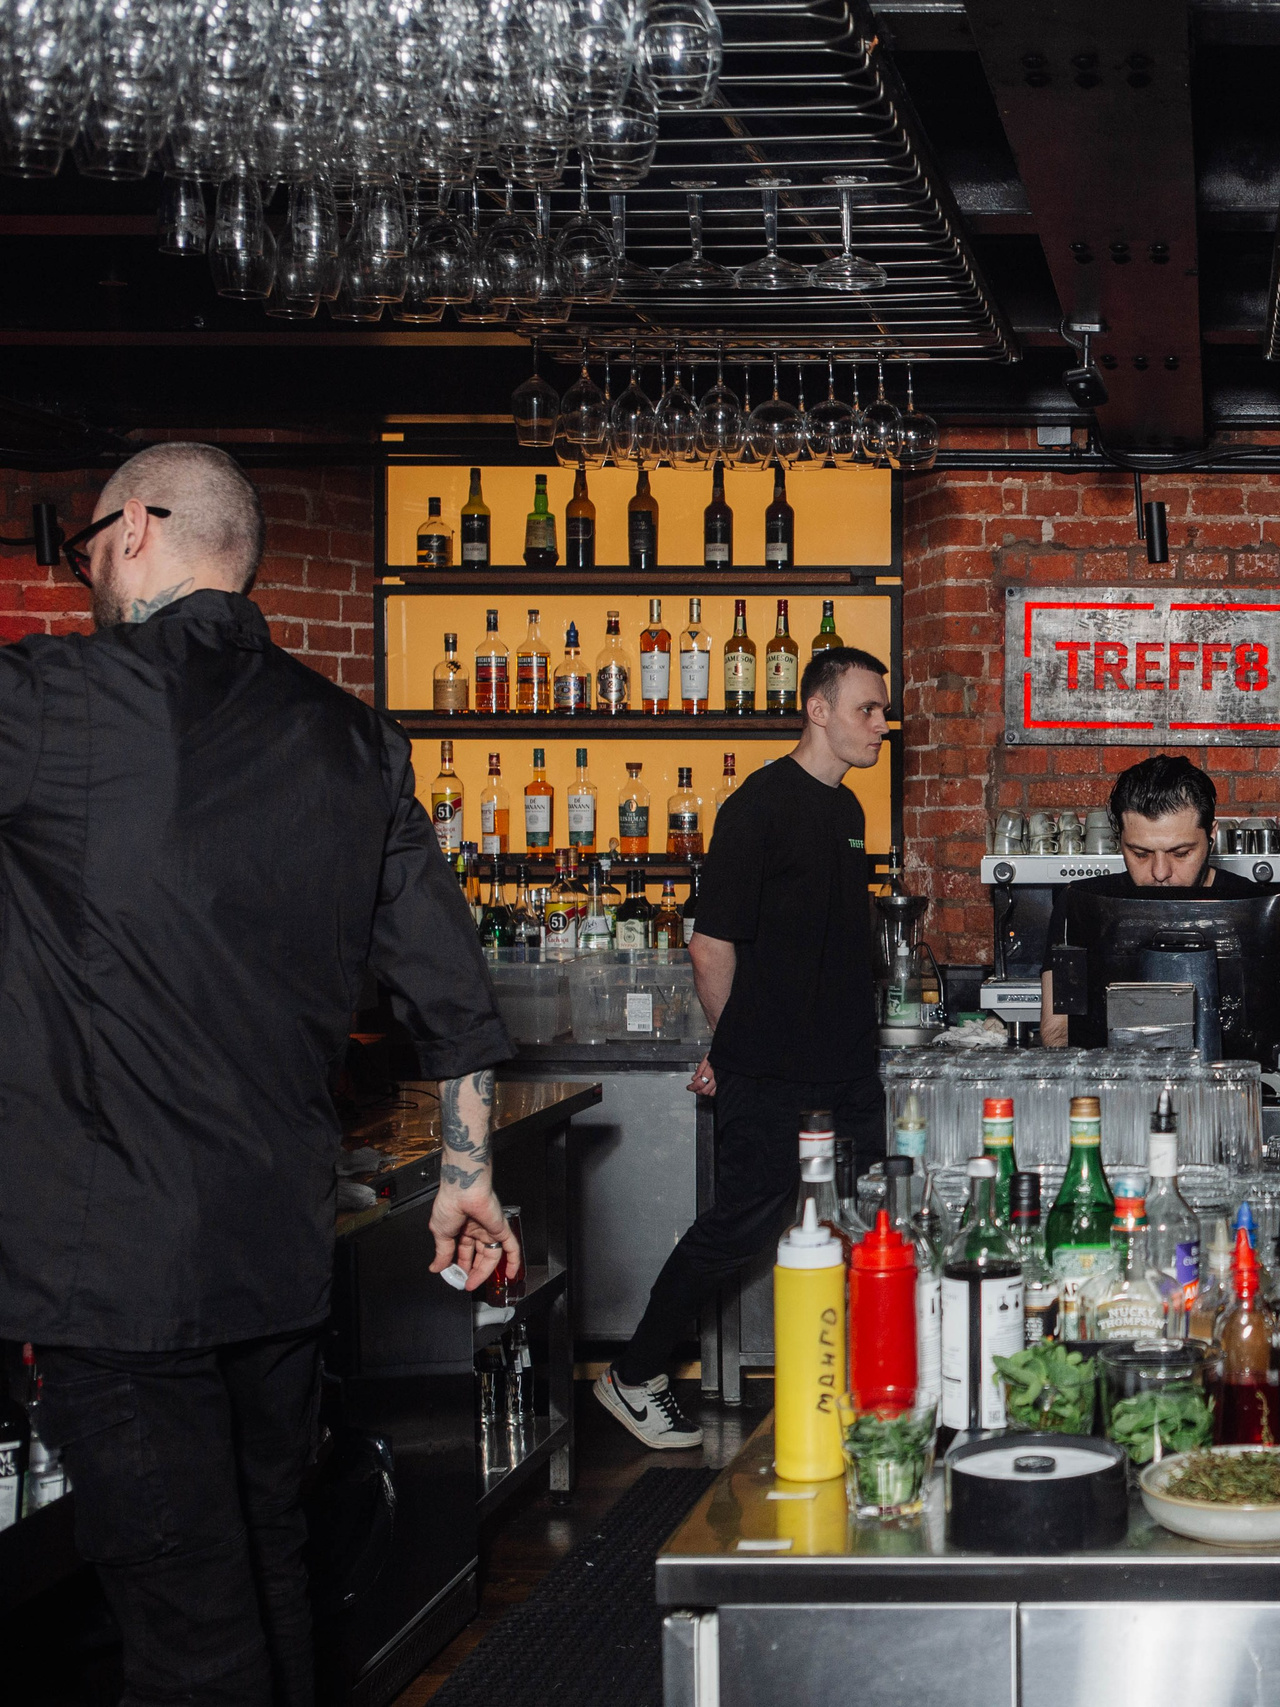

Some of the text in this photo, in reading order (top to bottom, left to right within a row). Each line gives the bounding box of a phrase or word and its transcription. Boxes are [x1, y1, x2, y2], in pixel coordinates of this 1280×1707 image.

[1055, 641, 1269, 691] TREFF8
[438, 806, 451, 818] 51
[551, 917, 565, 928] 51
[1108, 1306, 1157, 1319] NUCKY
[1108, 1330, 1157, 1339] APPLE PIE
